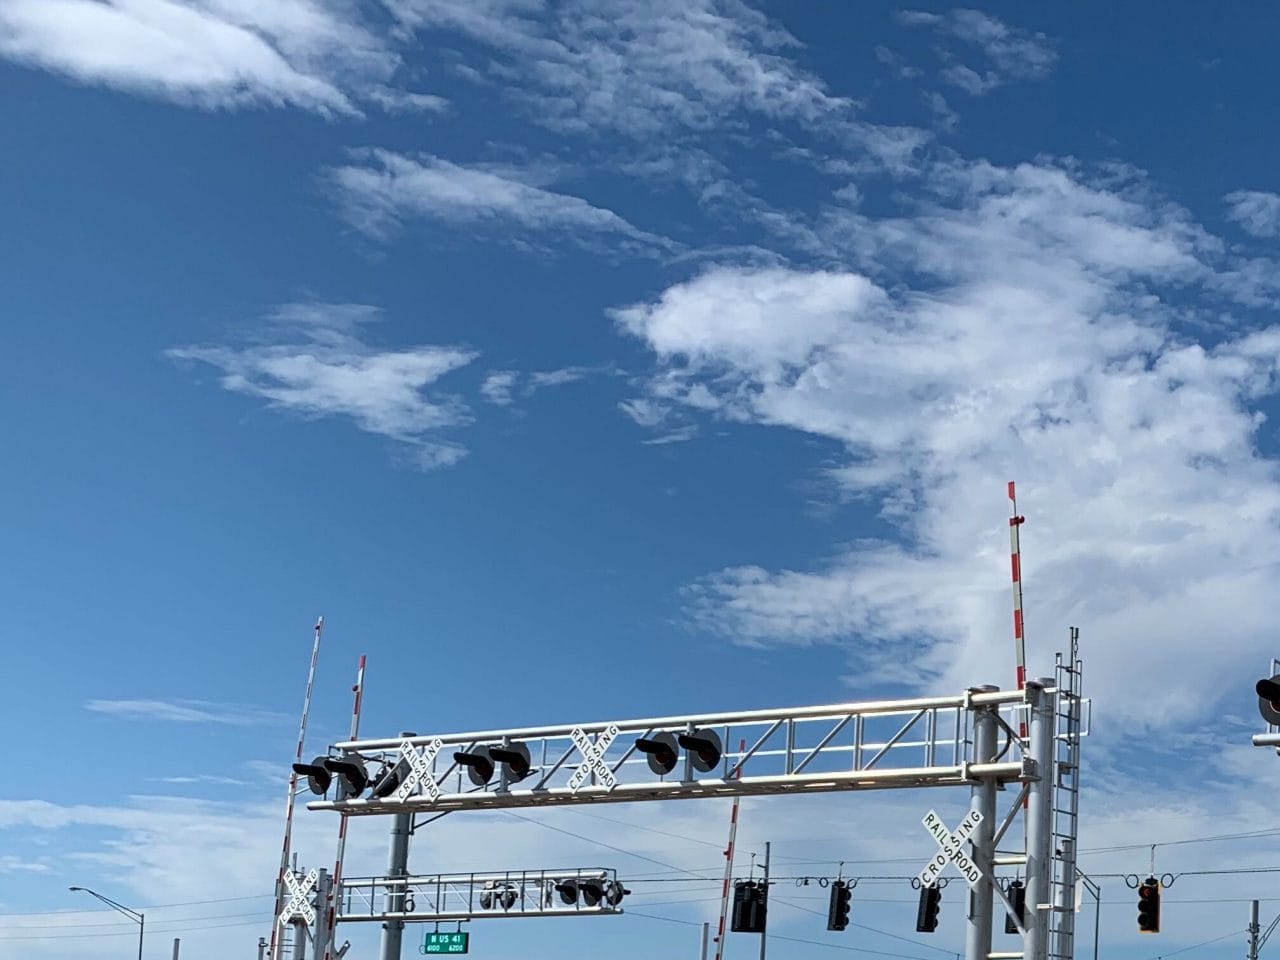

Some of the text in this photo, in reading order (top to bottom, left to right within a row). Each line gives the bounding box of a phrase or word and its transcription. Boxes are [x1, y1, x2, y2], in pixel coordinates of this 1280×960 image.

[398, 739, 440, 798] CROSSING
[570, 726, 616, 789] CROSSING
[922, 811, 980, 883] CROSSING
[282, 871, 316, 922] CROSSING
[431, 935, 460, 943] N US 41
